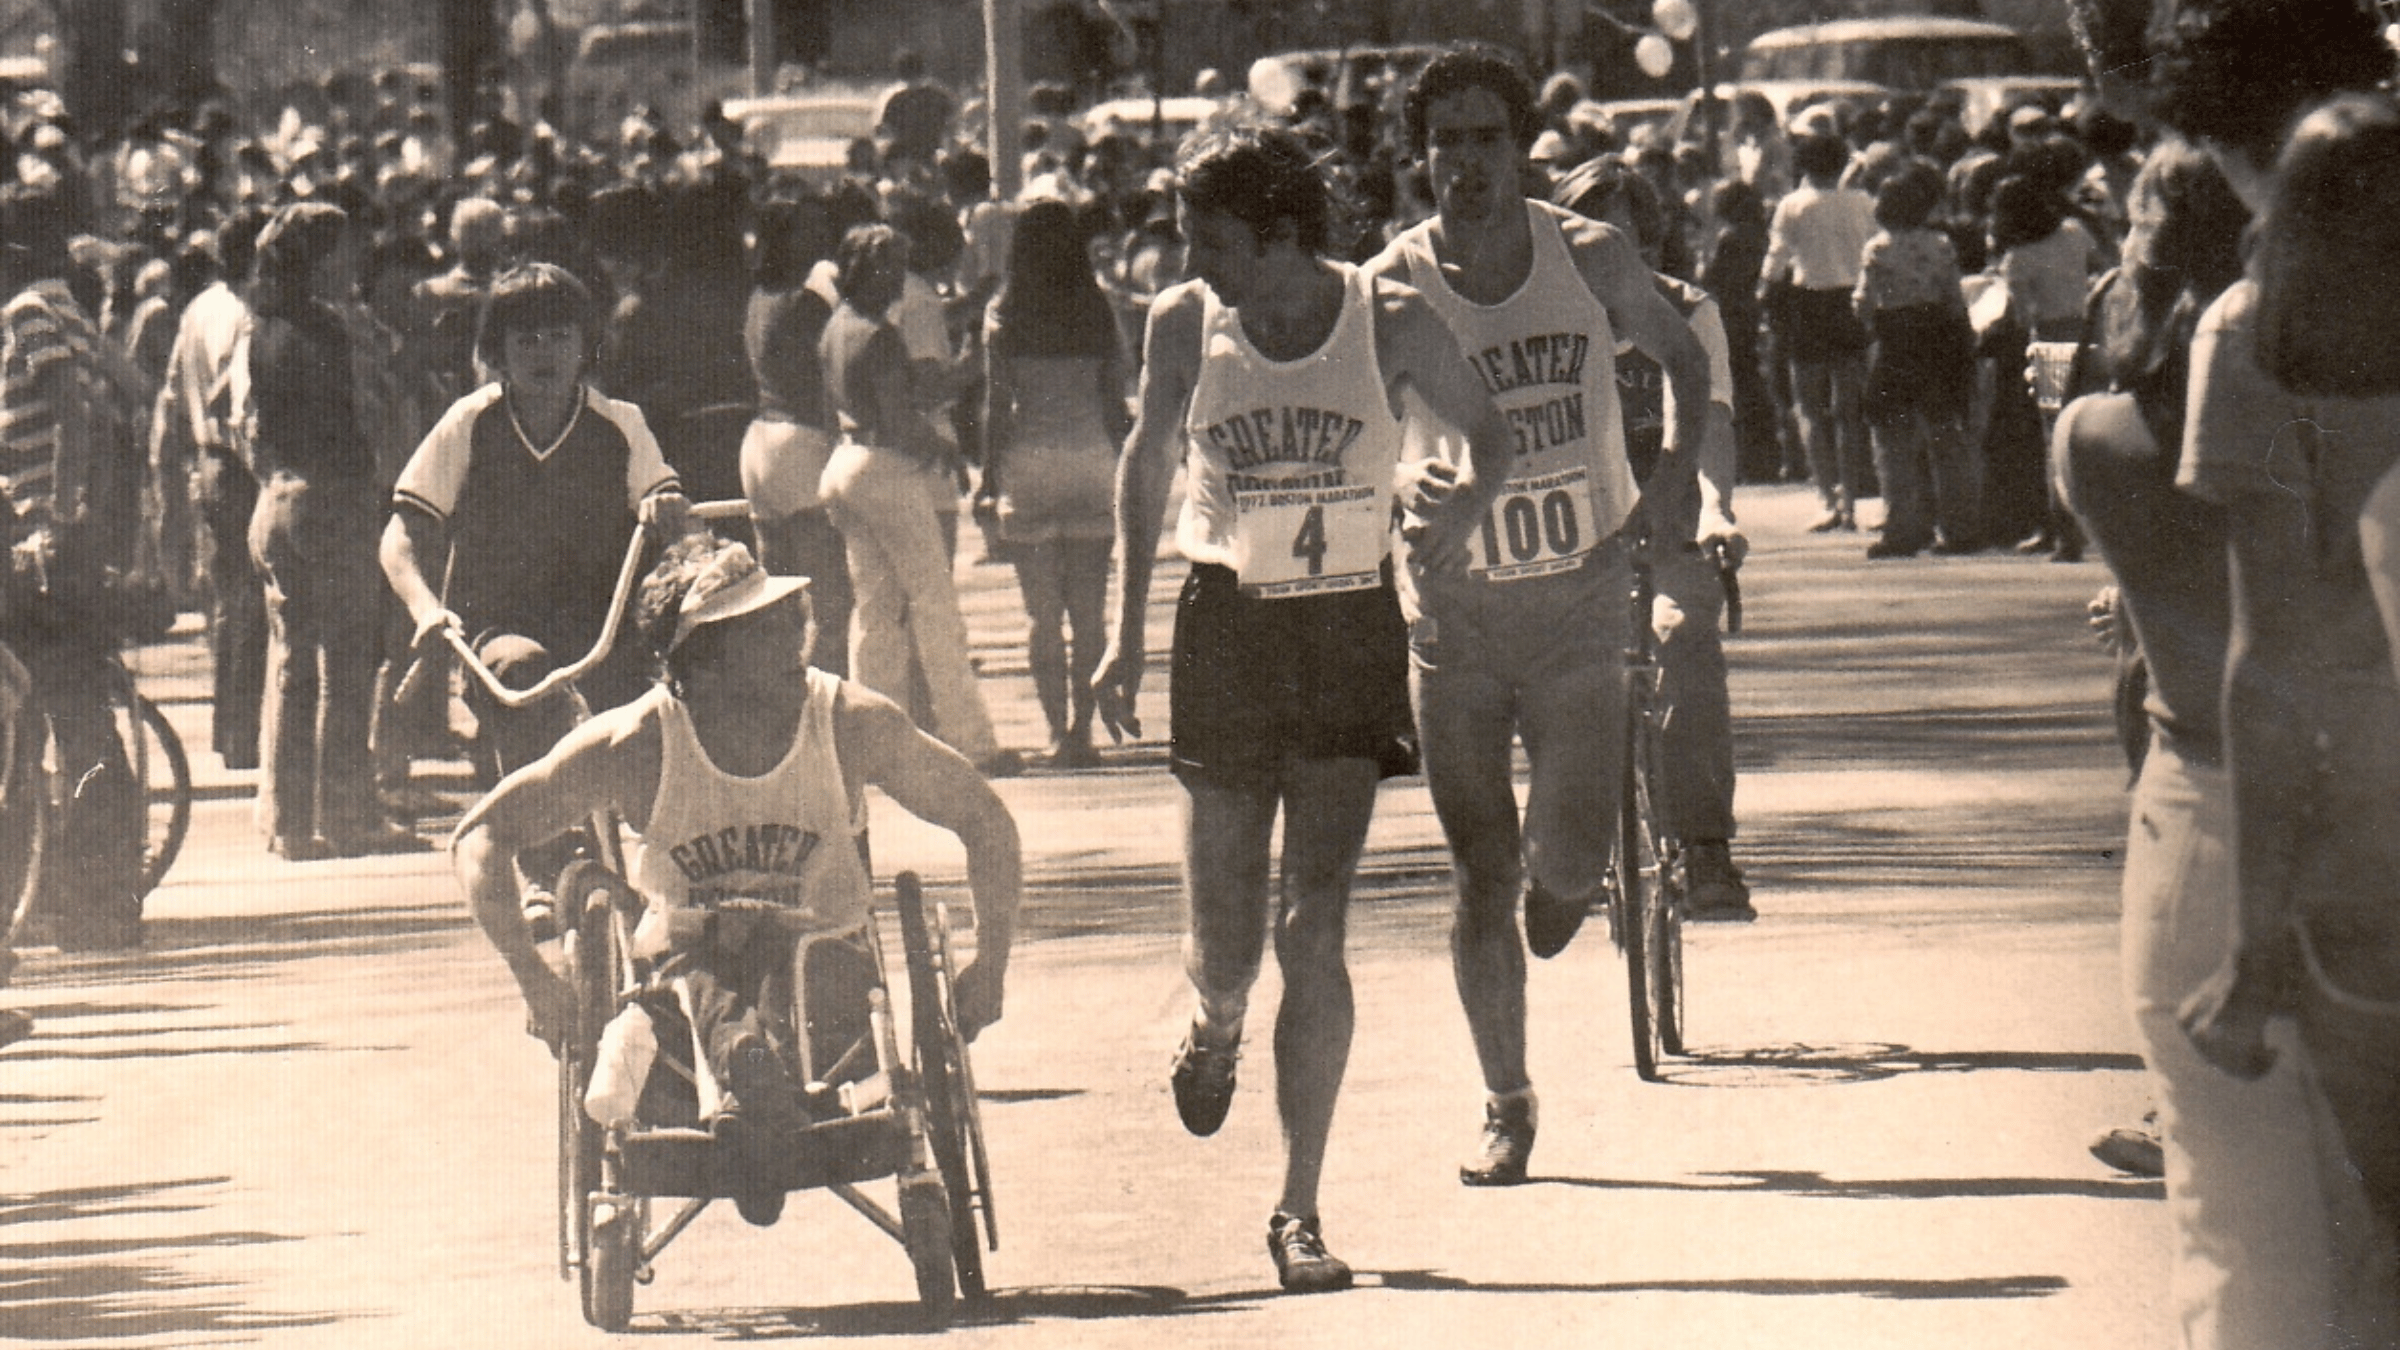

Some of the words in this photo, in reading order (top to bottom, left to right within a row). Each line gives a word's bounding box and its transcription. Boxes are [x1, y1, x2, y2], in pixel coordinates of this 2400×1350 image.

[1468, 331, 1588, 396] EATER
[1207, 406, 1364, 470] GREATER
[1504, 392, 1587, 456] STON
[1316, 486, 1375, 503] MARATHON
[1292, 505, 1327, 575] 4
[1480, 489, 1580, 566] 100
[669, 823, 822, 883] GREATER
